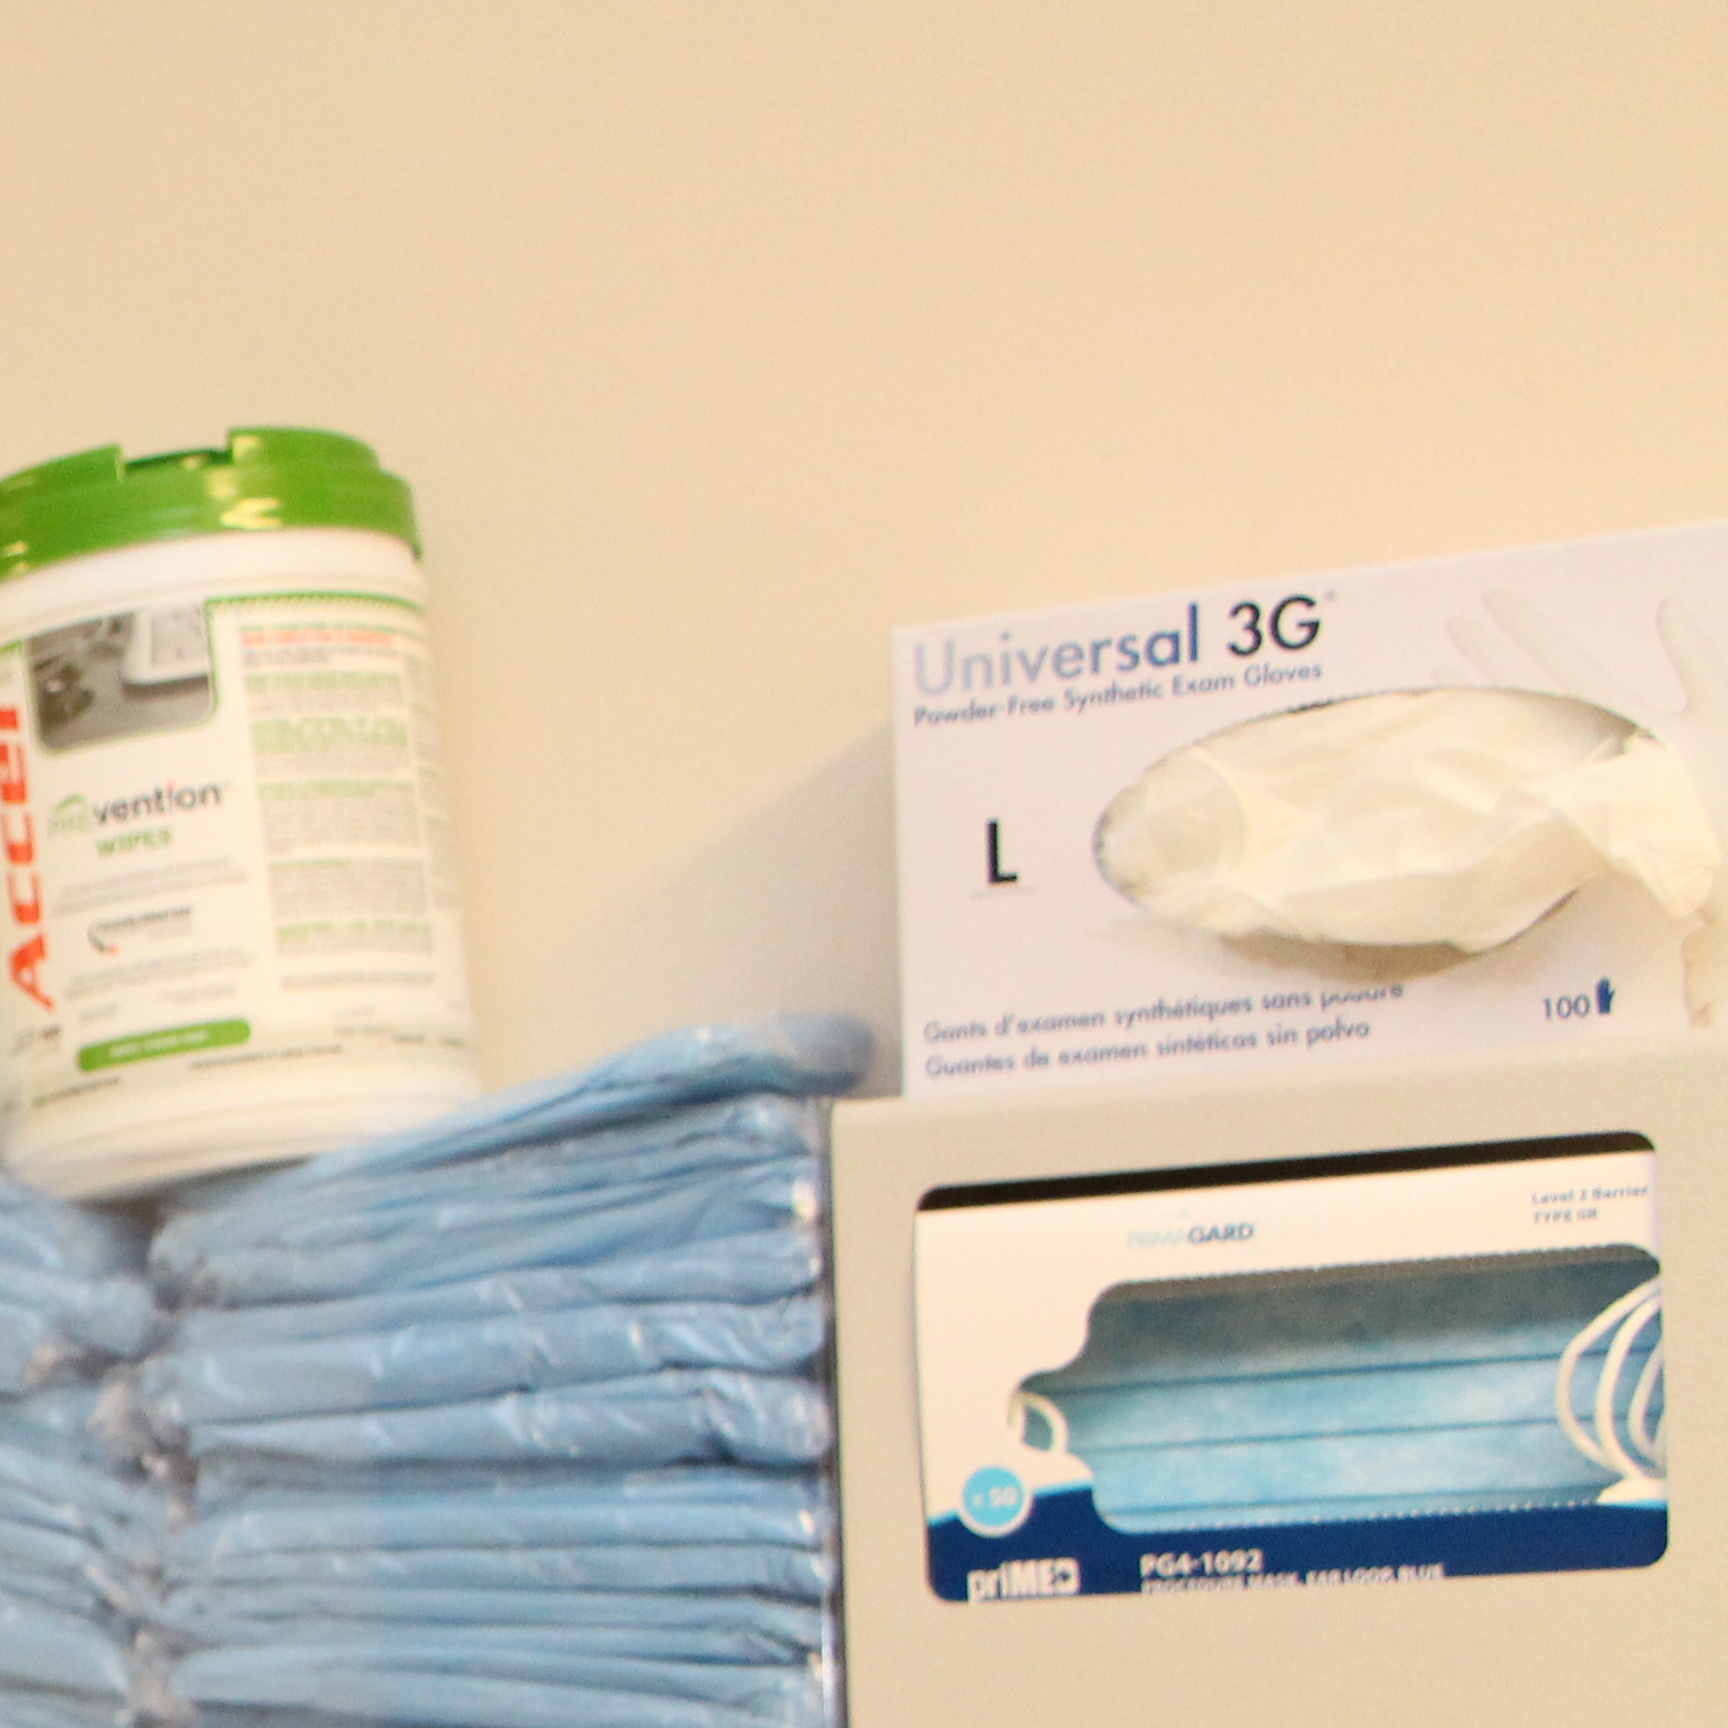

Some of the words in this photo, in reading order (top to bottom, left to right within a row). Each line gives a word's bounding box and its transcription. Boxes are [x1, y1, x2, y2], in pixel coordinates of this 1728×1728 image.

[914, 602, 1199, 695] Universal
[1227, 594, 1321, 657] 3G
[913, 697, 1055, 728] Powder-Free
[1065, 678, 1162, 714] Synthetic
[1172, 673, 1235, 696] Exam
[1244, 662, 1322, 687] Gloves
[985, 819, 1019, 885] L
[924, 1018, 987, 1044] Gants
[1261, 991, 1311, 1012] sans
[1542, 993, 1591, 1020] 100
[926, 1055, 1015, 1080] Guantes
[1023, 1046, 1050, 1069] de
[1058, 1042, 1146, 1067] examen
[1267, 1025, 1298, 1046] sin
[1306, 1017, 1370, 1047] polvo
[1532, 1188, 1573, 1205] Level
[1592, 1186, 1647, 1200] Barrier
[1534, 1210, 1572, 1223] TYPE
[1141, 1549, 1263, 1577] PG4-1092
